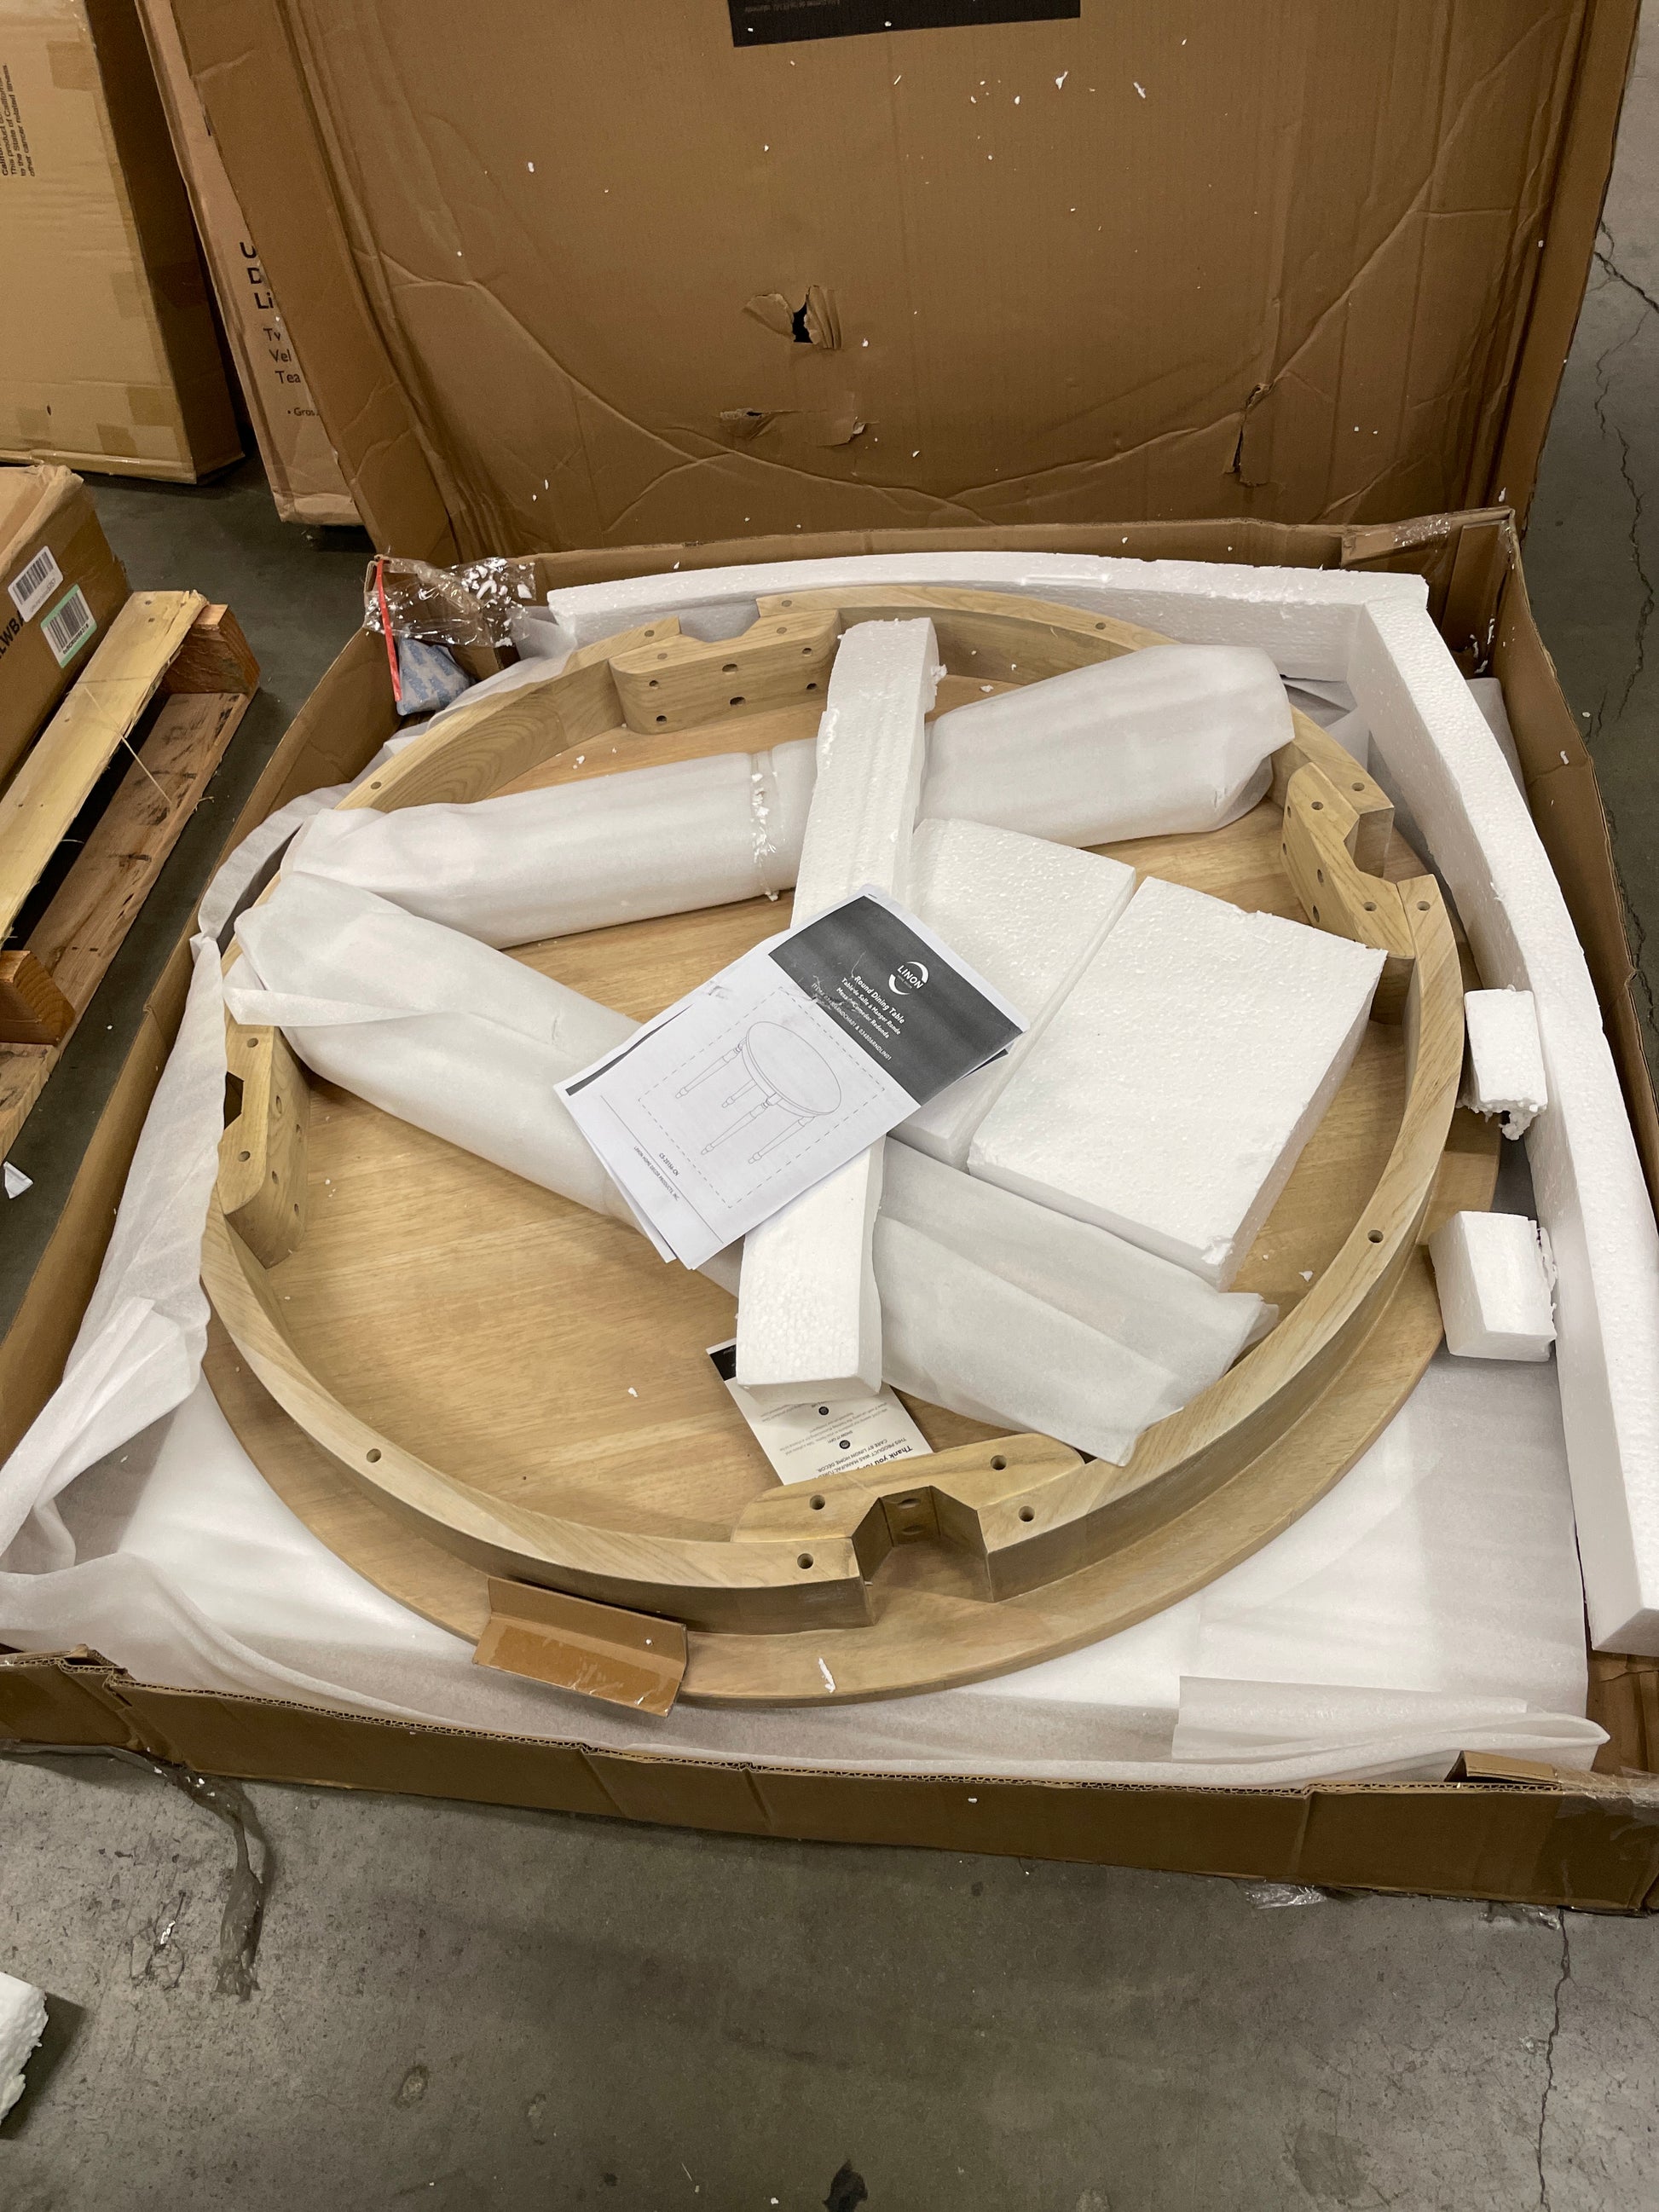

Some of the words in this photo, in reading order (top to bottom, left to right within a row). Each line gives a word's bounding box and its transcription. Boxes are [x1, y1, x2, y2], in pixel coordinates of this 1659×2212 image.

[9, 94, 21, 124] related
[5, 118, 14, 128] of
[0, 125, 14, 157] product
[10, 130, 20, 151] State
[17, 125, 29, 153] cancer
[26, 155, 36, 177] other
[897, 965, 924, 989] LINON
[841, 977, 854, 991] Table
[858, 994, 870, 1006] Salle
[871, 1006, 888, 1022] Manger
[886, 1019, 901, 1035] Ronde
[853, 975, 875, 994] Round
[870, 991, 890, 1011] Dining
[888, 1007, 905, 1024] Table
[835, 987, 848, 1000] Mesa
[852, 1001, 872, 1021] Comedor
[870, 1019, 889, 1038] Redonda
[870, 1442, 895, 1457] PRODUCT
[874, 1439, 887, 1447] CARE
[894, 1437, 907, 1446] THIS
[835, 1456, 851, 1465] HOME
[850, 1447, 868, 1458] LINON
[858, 1453, 871, 1462] WAS
[874, 1454, 888, 1466] you
[888, 1445, 913, 1458] Thank
